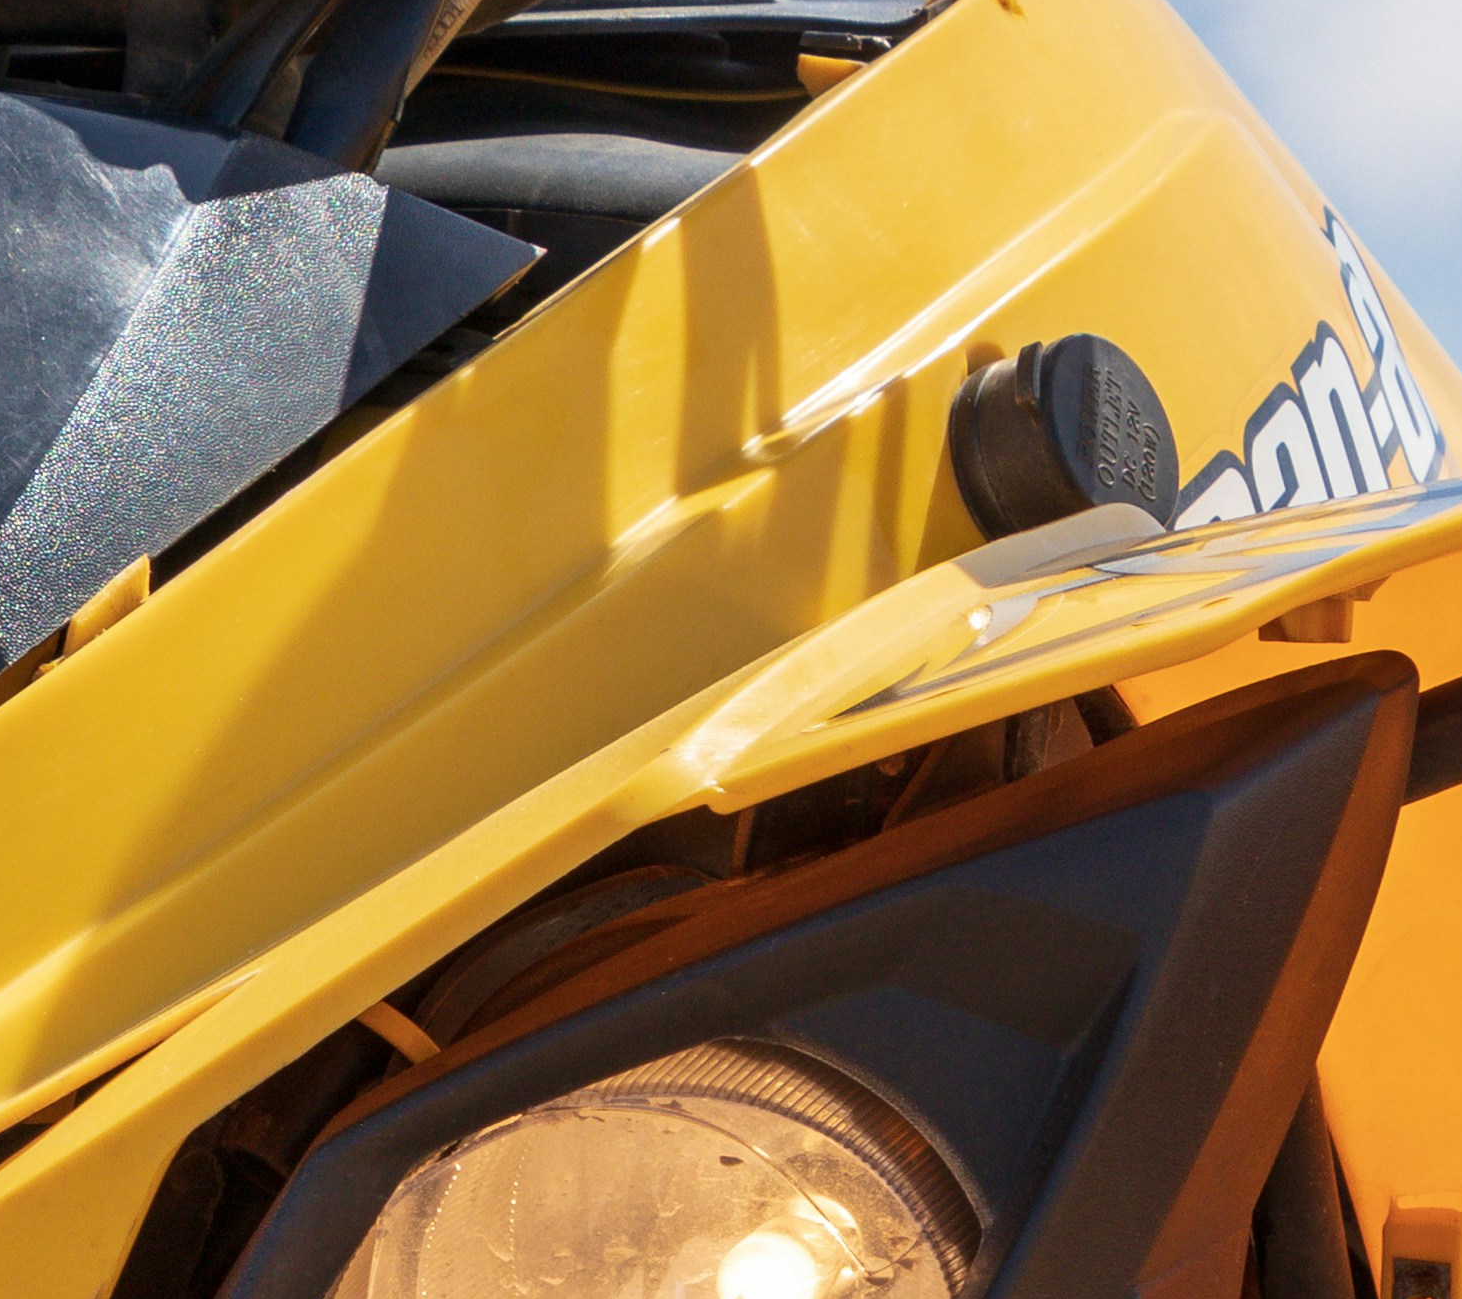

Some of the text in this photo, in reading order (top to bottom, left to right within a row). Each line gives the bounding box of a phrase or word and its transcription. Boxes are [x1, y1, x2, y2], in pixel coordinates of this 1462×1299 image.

[1097, 367, 1124, 489] OUTLET
[1122, 396, 1142, 492] DC 12V
[1138, 421, 1162, 503] (120W)
